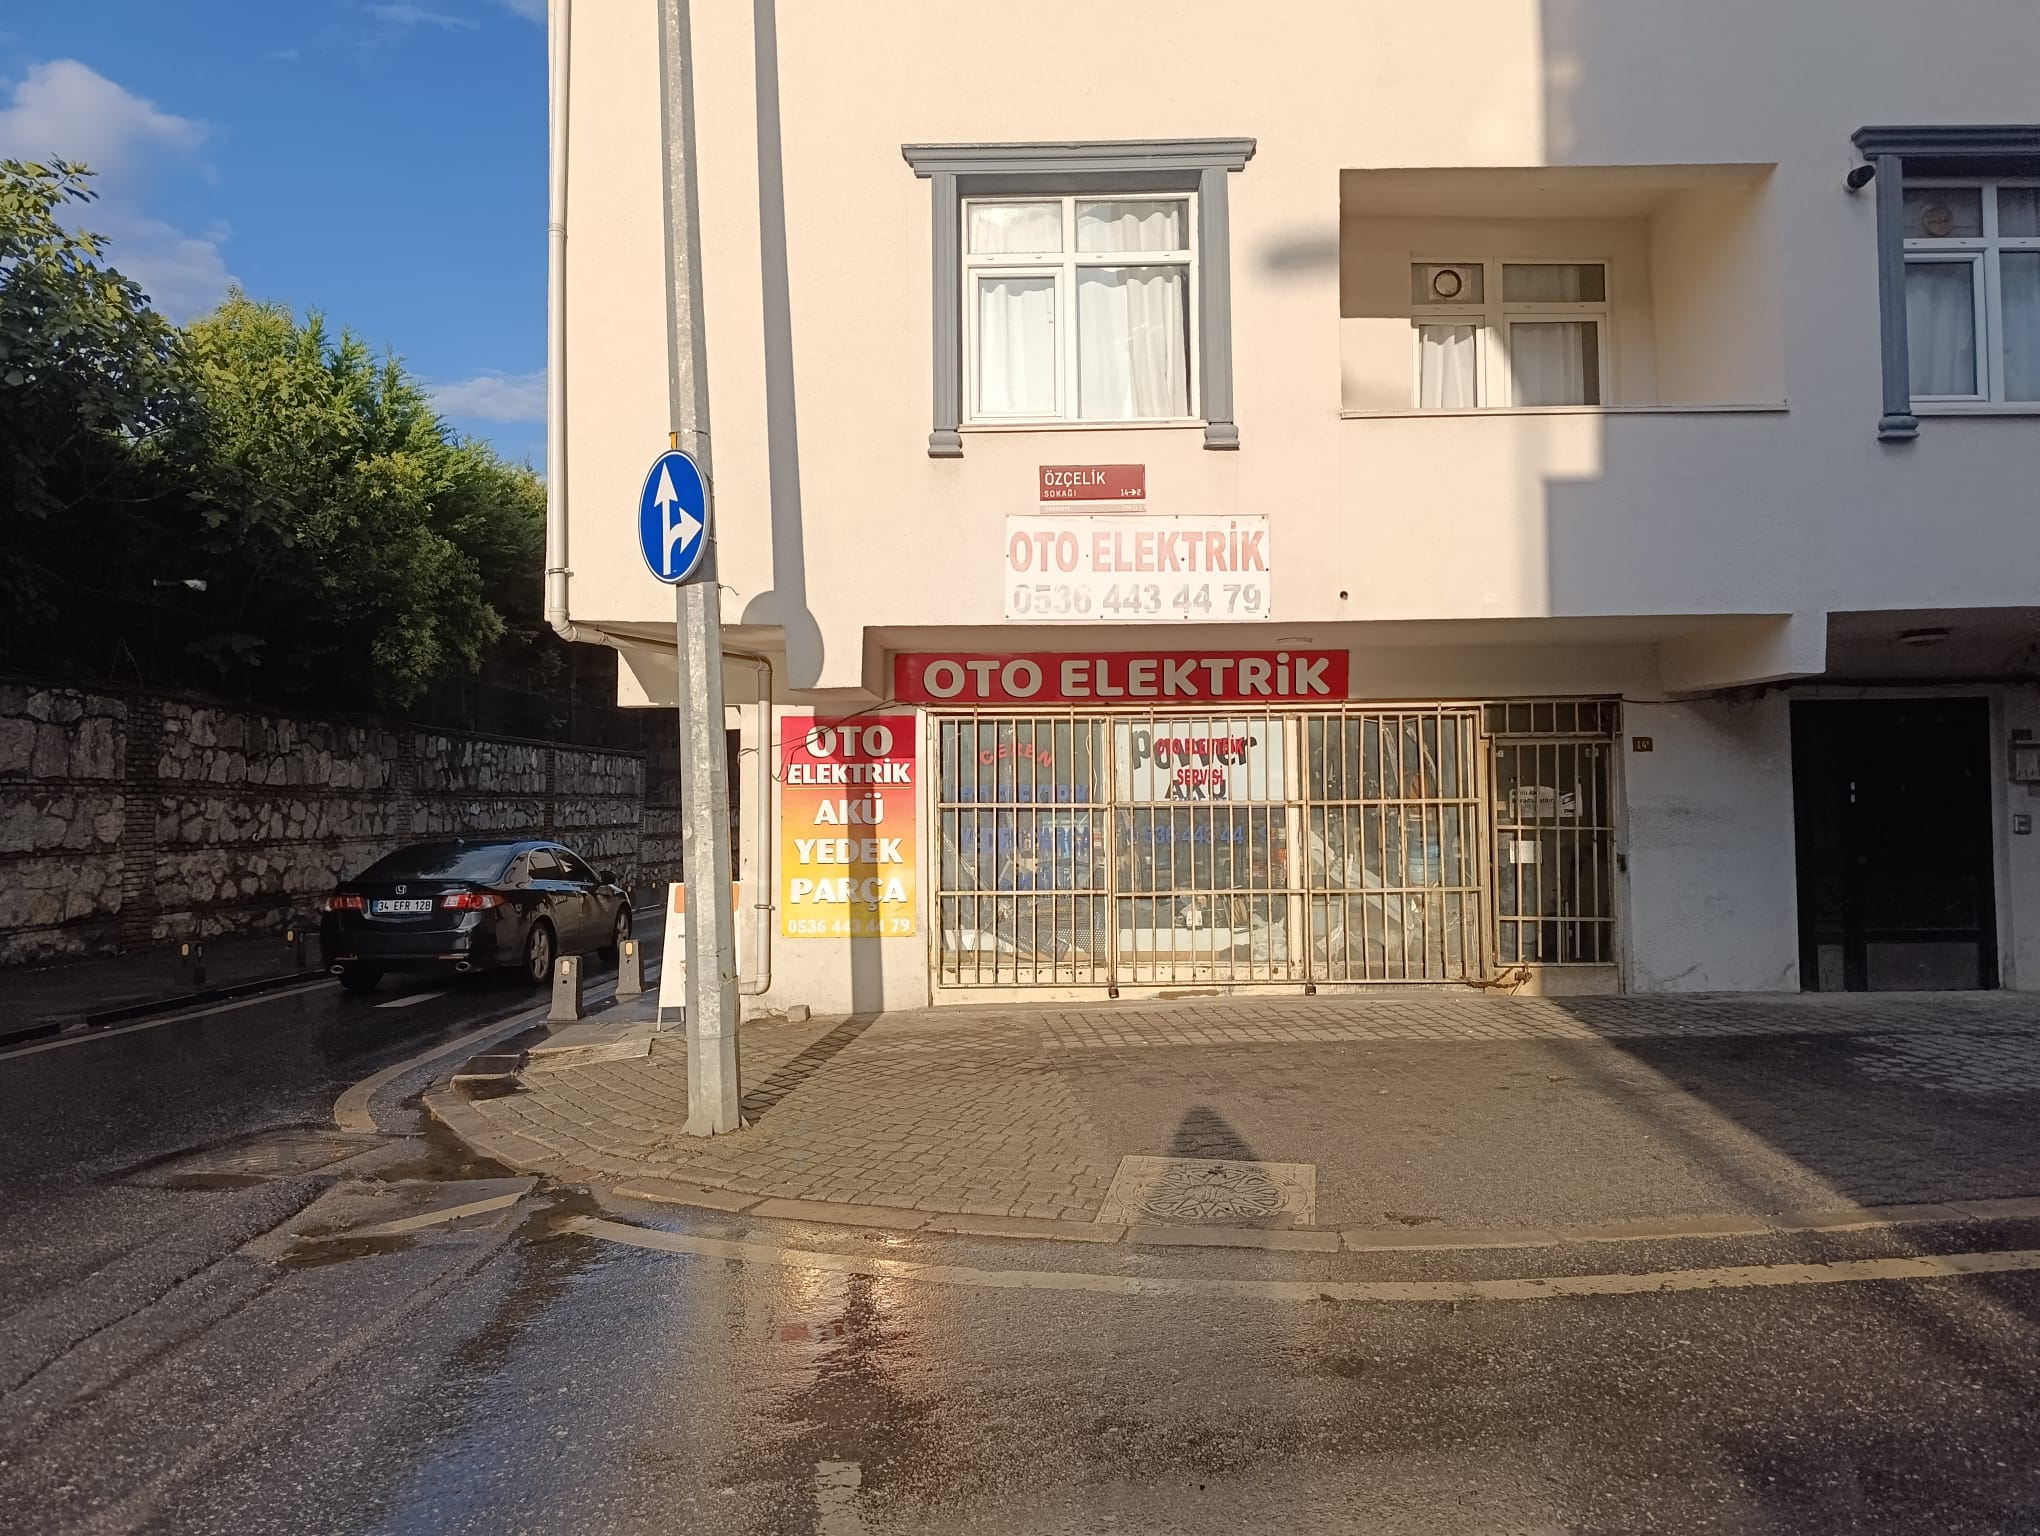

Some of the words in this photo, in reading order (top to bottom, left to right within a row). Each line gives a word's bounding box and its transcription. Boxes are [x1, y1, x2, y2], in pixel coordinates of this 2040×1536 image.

[1044, 469, 1106, 488] ÖZÇELİK
[1043, 489, 1077, 498] SOKAĞI
[1009, 530, 1079, 572] OTO
[1092, 520, 1265, 572] ELEKTRİK
[1013, 583, 1092, 614] 0536
[1102, 584, 1162, 614] 443
[1172, 584, 1212, 614] 44
[1223, 584, 1262, 614] 79
[923, 658, 1043, 698] OTO
[1060, 652, 1331, 698] ELEKTRİK
[804, 725, 893, 758] OTO
[787, 758, 911, 785] ELEKTRİK
[1177, 765, 1224, 786] SERVSİ
[813, 791, 885, 825] AKÜ
[793, 838, 905, 865] YEDEK
[378, 901, 389, 911] 34
[393, 901, 411, 911] EFR
[415, 900, 431, 910] 128
[790, 876, 908, 912] PARÇA
[787, 919, 827, 934] 0536
[832, 919, 861, 934] 443
[891, 917, 911, 933] 79
